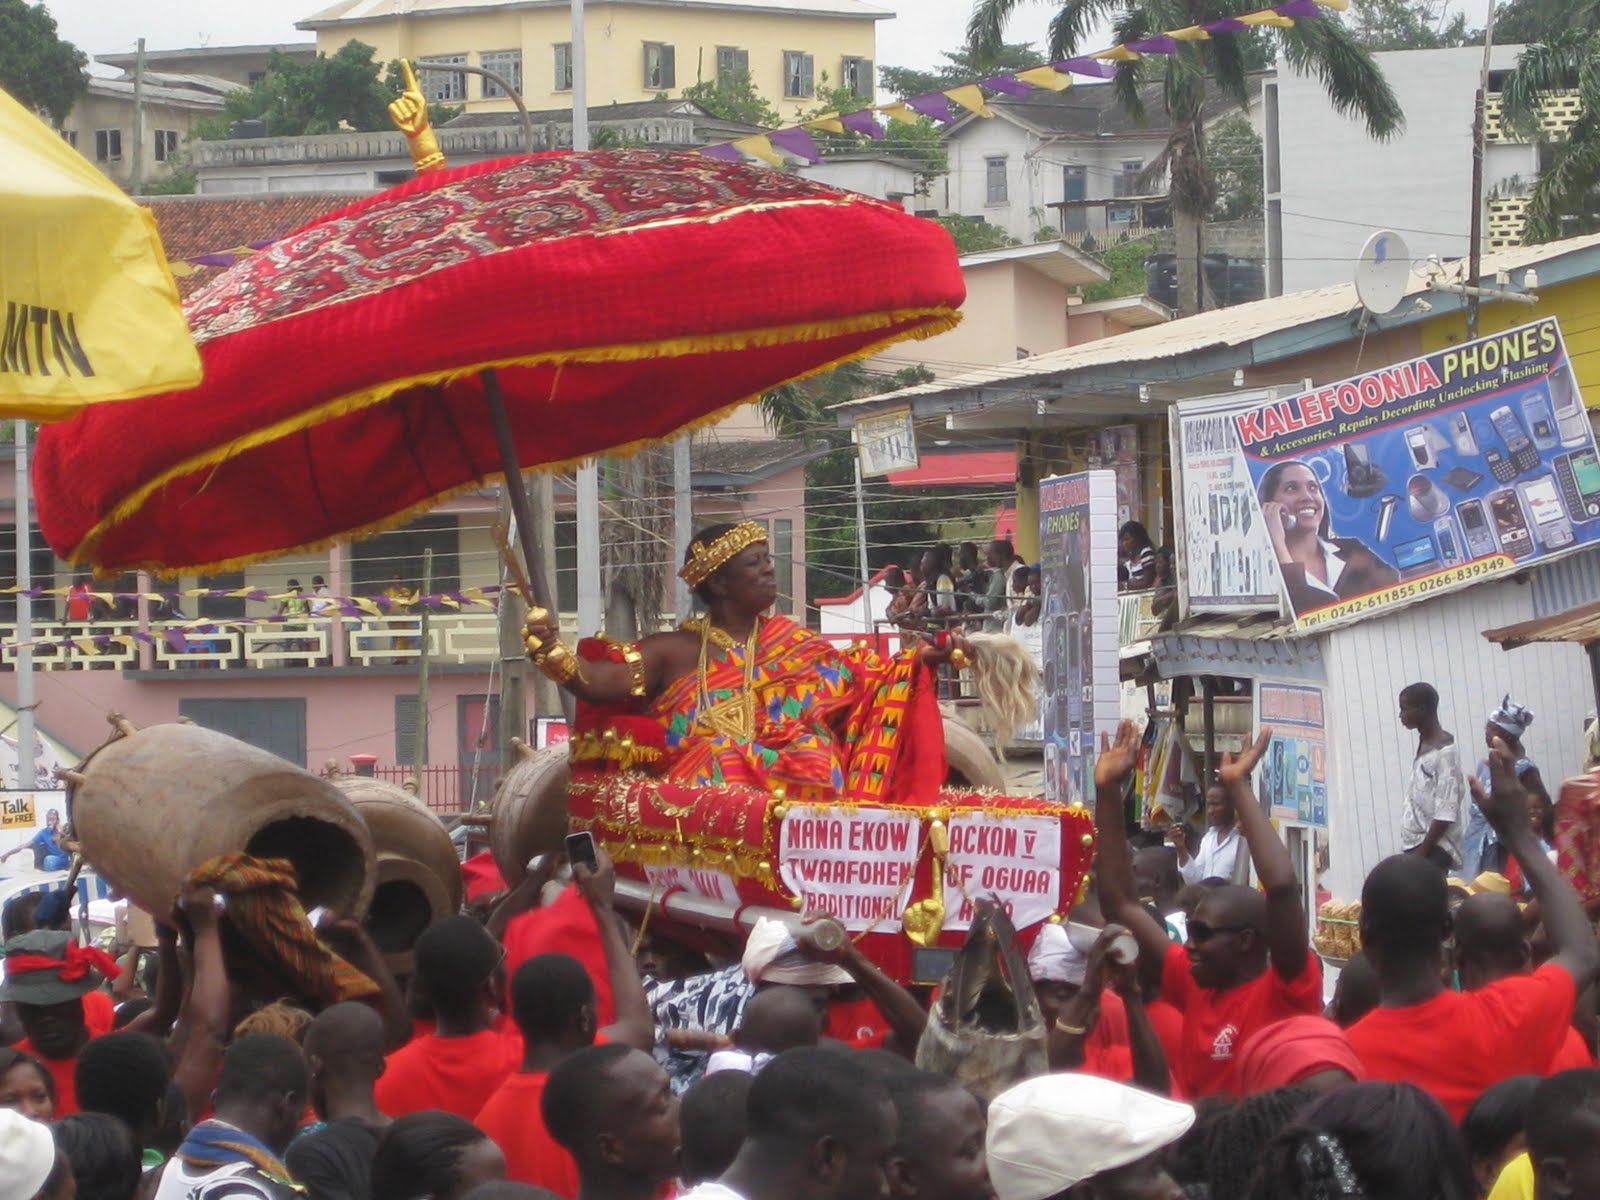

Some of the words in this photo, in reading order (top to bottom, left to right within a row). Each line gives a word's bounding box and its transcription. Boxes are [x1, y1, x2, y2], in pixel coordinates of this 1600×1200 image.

[0, 301, 96, 377] MTN
[1237, 359, 1441, 445] KALEFOONIA
[1443, 322, 1557, 384] PHONES
[1260, 446, 1270, 457] &
[1272, 429, 1337, 454] Accessories,
[1339, 414, 1379, 434] Repairs
[1382, 398, 1437, 421] Decording
[1439, 377, 1499, 403] Unclocking
[1502, 361, 1549, 384] Flashing
[1047, 511, 1080, 534] PHONES
[1302, 614, 1327, 628] Tel:
[1331, 585, 1416, 620] 0242-611855
[1420, 557, 1505, 592] 0266-839349
[0, 798, 29, 814] Talk
[2, 815, 13, 825] for
[788, 819, 842, 849] NANA
[848, 821, 910, 851] EKOW
[950, 825, 1017, 857] ACKON
[1021, 830, 1037, 859] V
[787, 858, 911, 886] TWAAFOHEN
[946, 864, 973, 888] OF
[981, 866, 1050, 893] OGUAA
